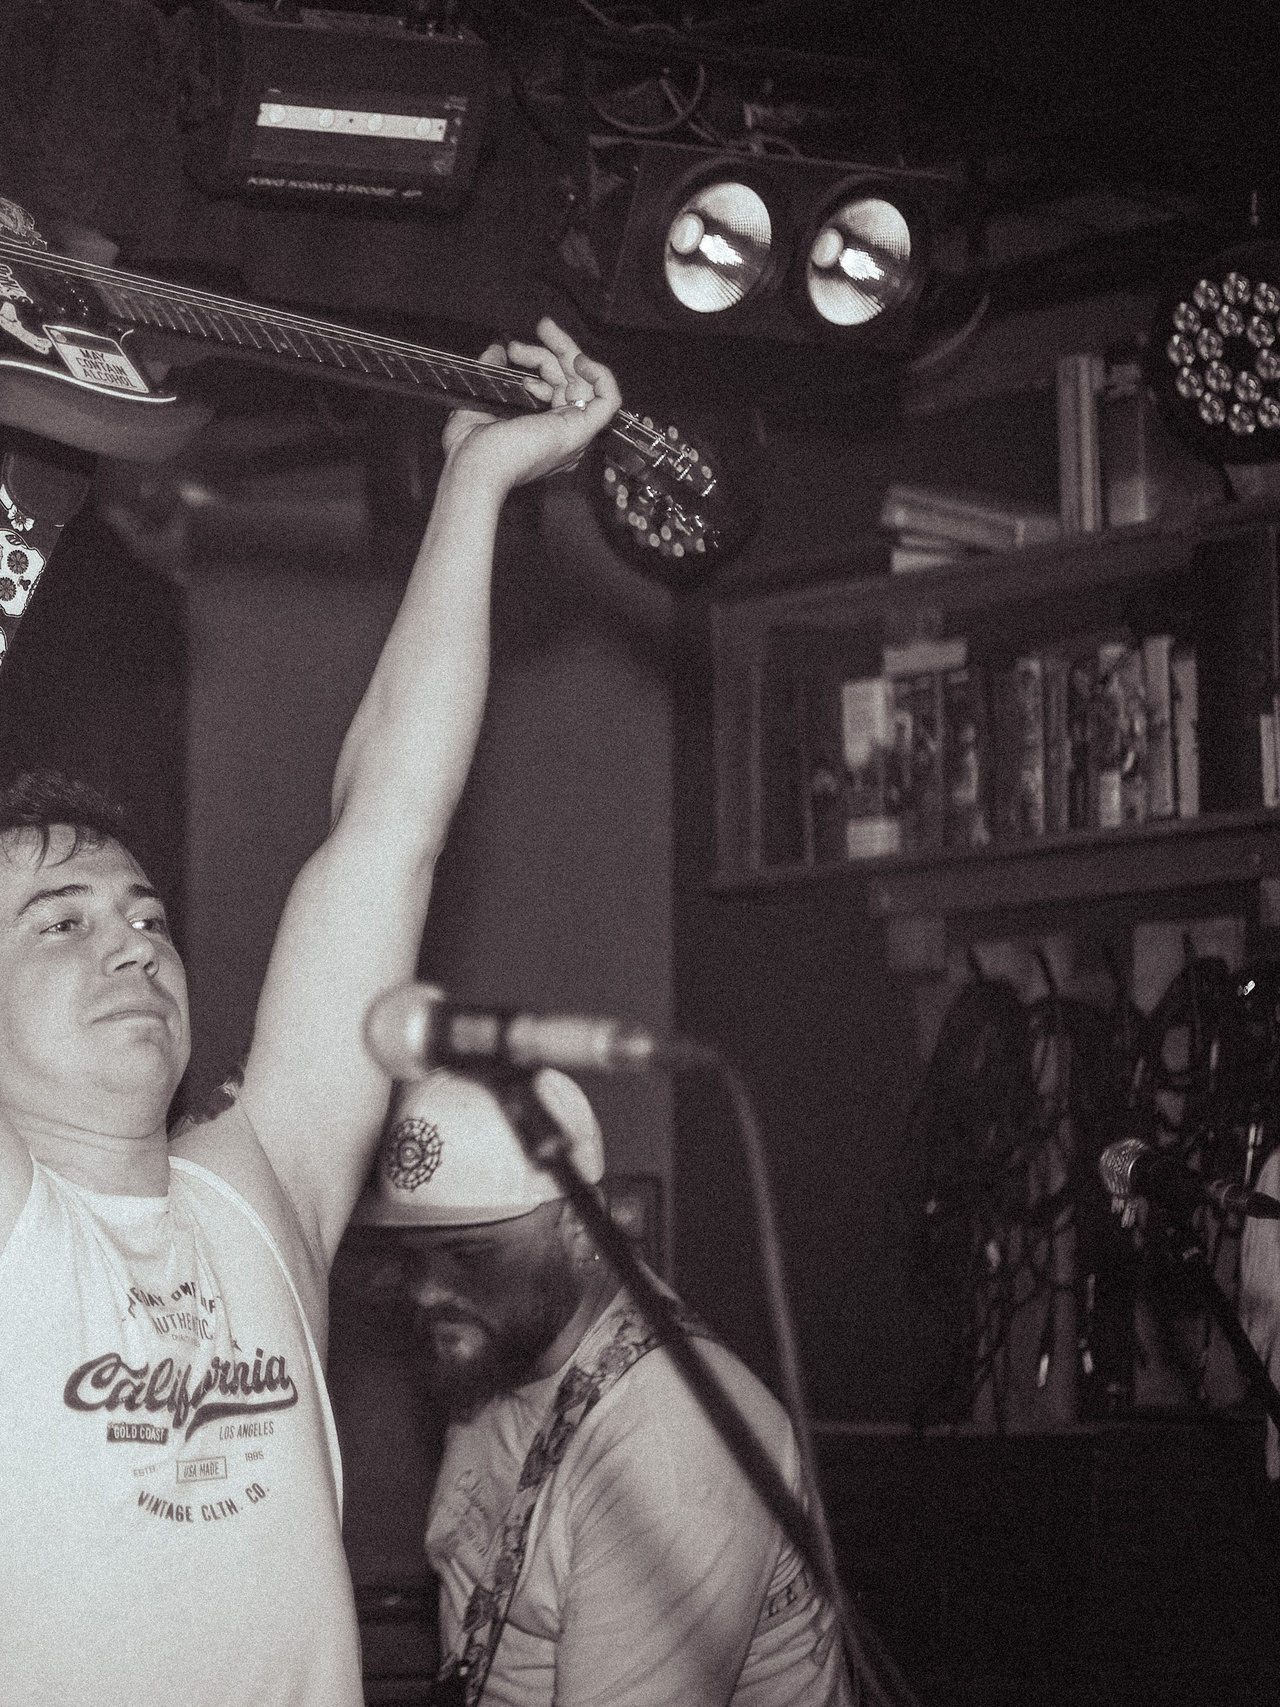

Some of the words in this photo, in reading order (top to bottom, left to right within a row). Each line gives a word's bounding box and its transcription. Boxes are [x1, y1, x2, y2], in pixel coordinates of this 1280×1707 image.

[79, 348, 107, 362] MAY
[76, 357, 128, 377] CONTAIN
[82, 367, 138, 388] ALCOHOL
[63, 1348, 298, 1442] Califrnia
[114, 1426, 138, 1439] GOLD
[140, 1427, 165, 1441] COAST
[219, 1425, 236, 1441] LOS
[237, 1421, 275, 1438] ANGELES
[199, 1461, 220, 1476] MADE
[137, 1490, 194, 1523] VINTAGE
